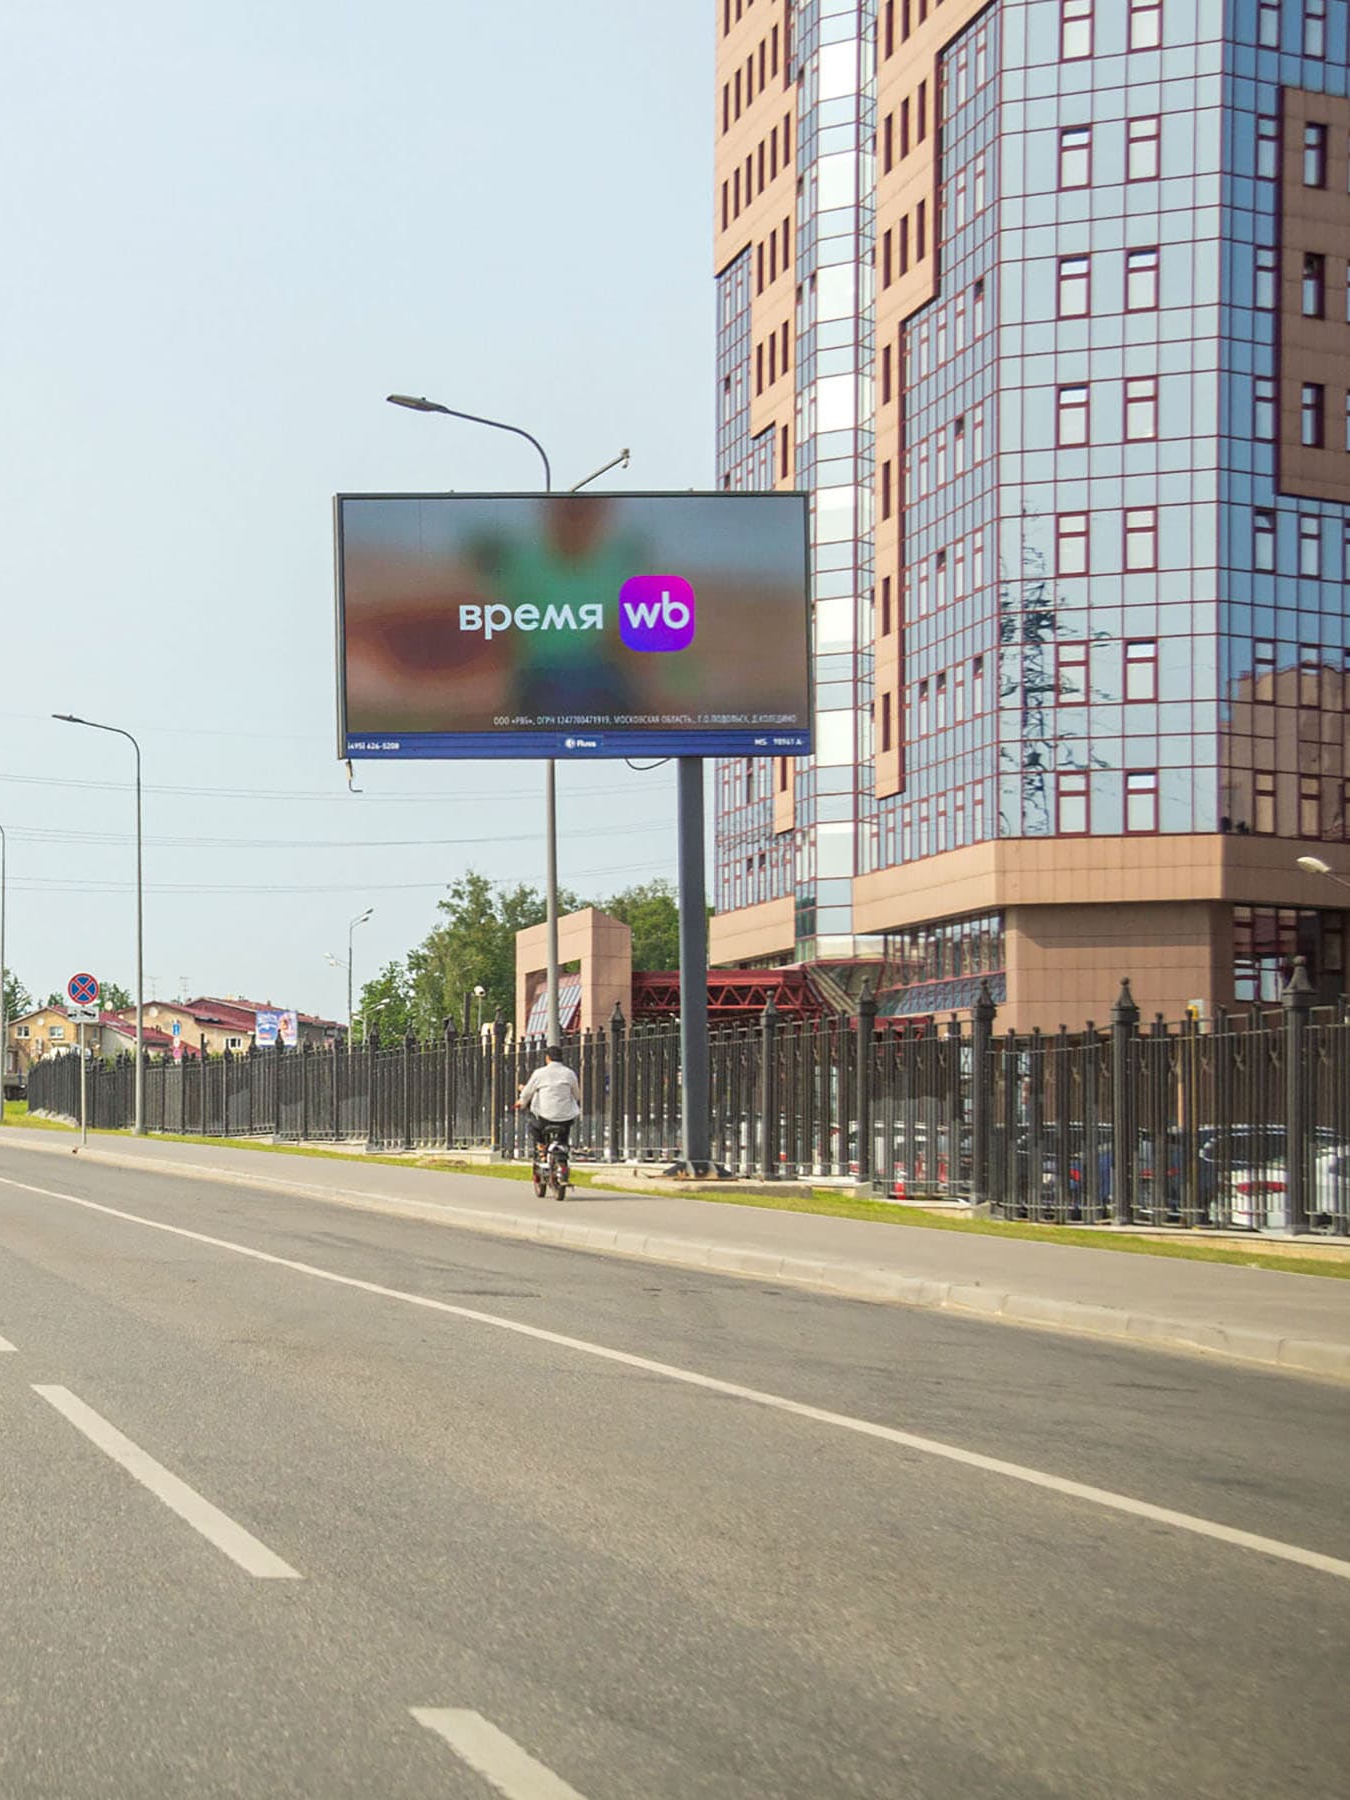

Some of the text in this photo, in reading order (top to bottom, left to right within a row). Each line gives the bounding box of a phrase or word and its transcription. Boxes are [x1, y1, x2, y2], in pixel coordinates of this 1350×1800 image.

[458, 603, 604, 640] время
[623, 591, 691, 630] wb
[492, 715, 510, 726] ООО
